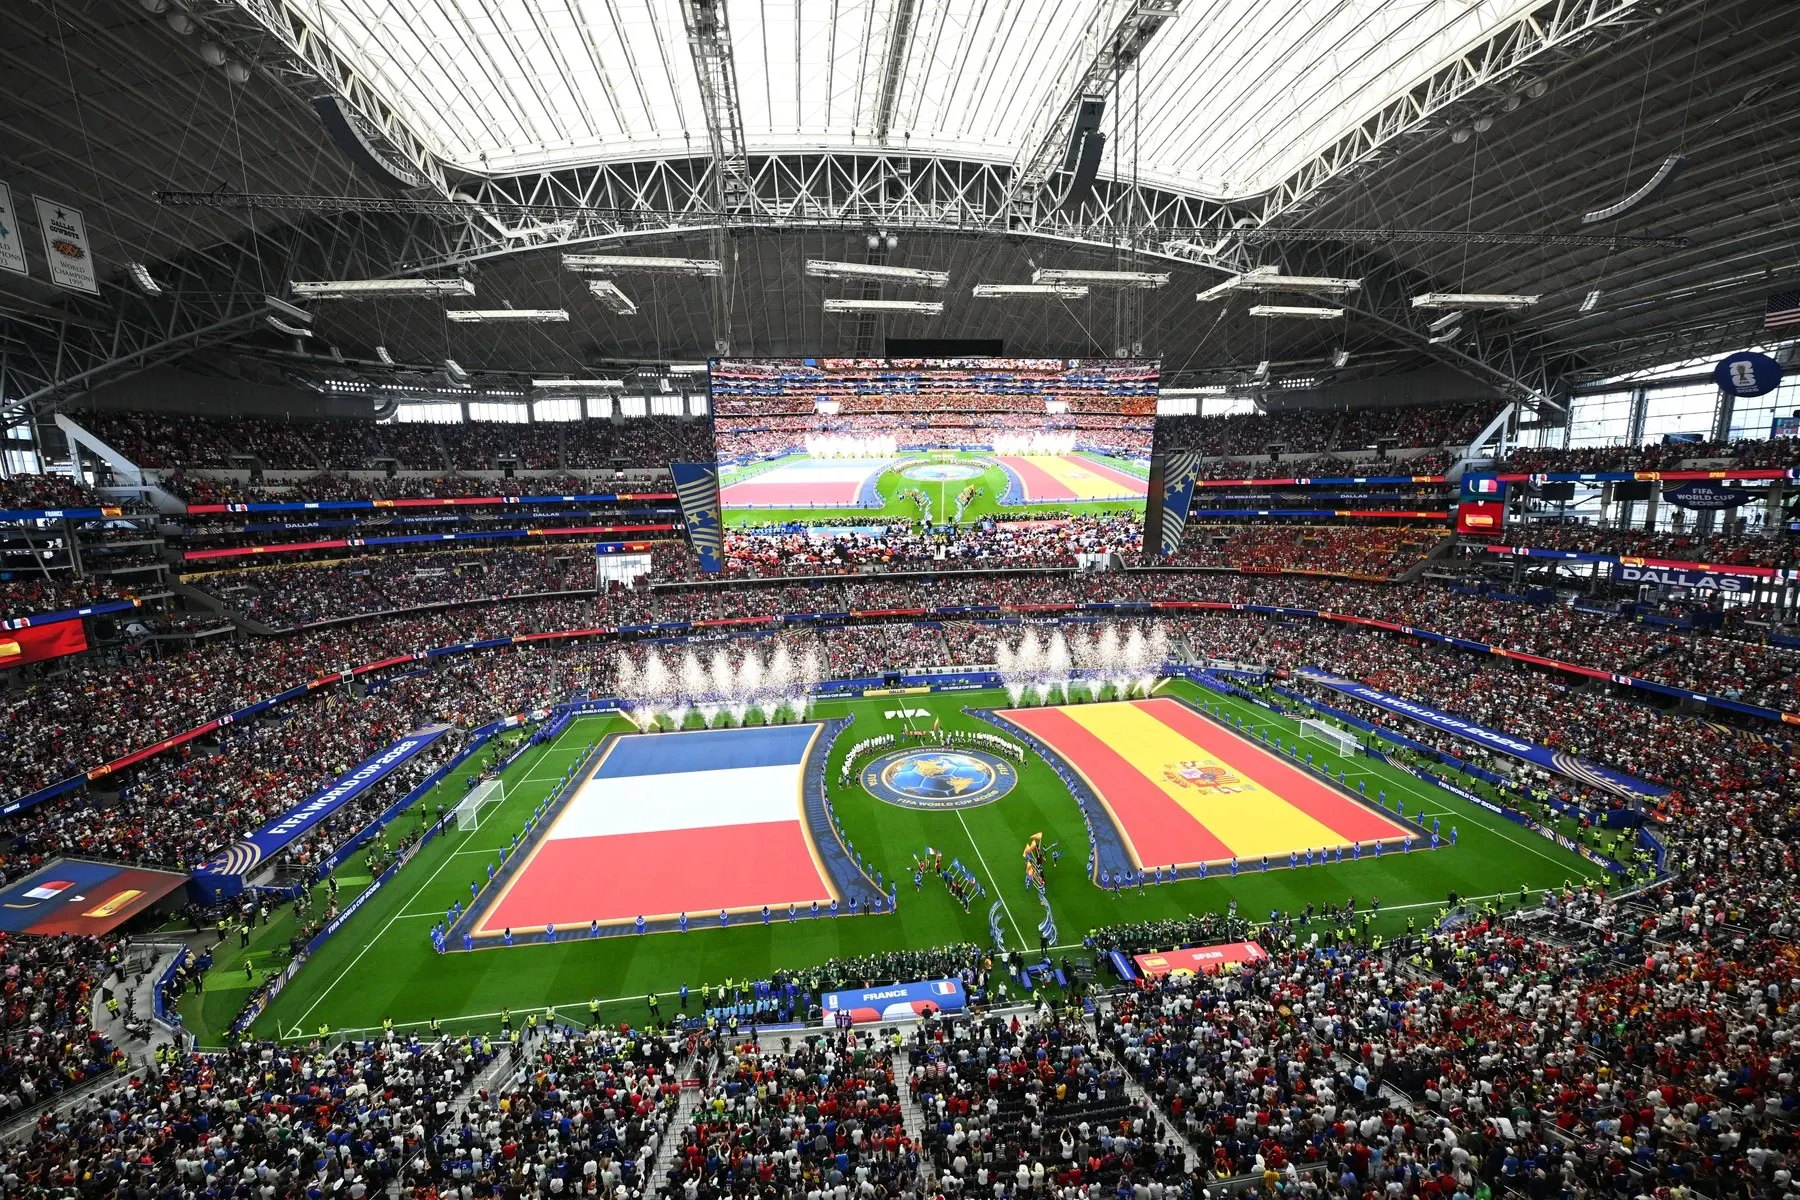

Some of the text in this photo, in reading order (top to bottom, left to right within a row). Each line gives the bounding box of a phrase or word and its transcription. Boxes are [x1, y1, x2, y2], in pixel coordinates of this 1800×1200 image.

[49, 225, 79, 239] COWBOYS
[50, 219, 75, 232] DALLAS
[60, 261, 85, 273] WORLD
[69, 278, 84, 287] 1995
[1622, 568, 1742, 592] DALLAS
[886, 709, 931, 719] FIFA
[1354, 688, 1532, 752] FIFA WORLD CUP 2026
[996, 763, 1009, 776] FIFA
[268, 740, 418, 834] FIFA WORLD CUP 2026
[868, 774, 878, 787] FIFA
[896, 798, 917, 806] FIFA
[973, 790, 999, 803] 2026
[1438, 780, 1502, 814] FIFA WORLD CUP 2026
[4, 803, 20, 813] FRANCE
[328, 881, 381, 934] FIFA WORLD CUP 2026
[1192, 951, 1224, 961] SPAIN
[863, 989, 908, 1001] FRANCE
